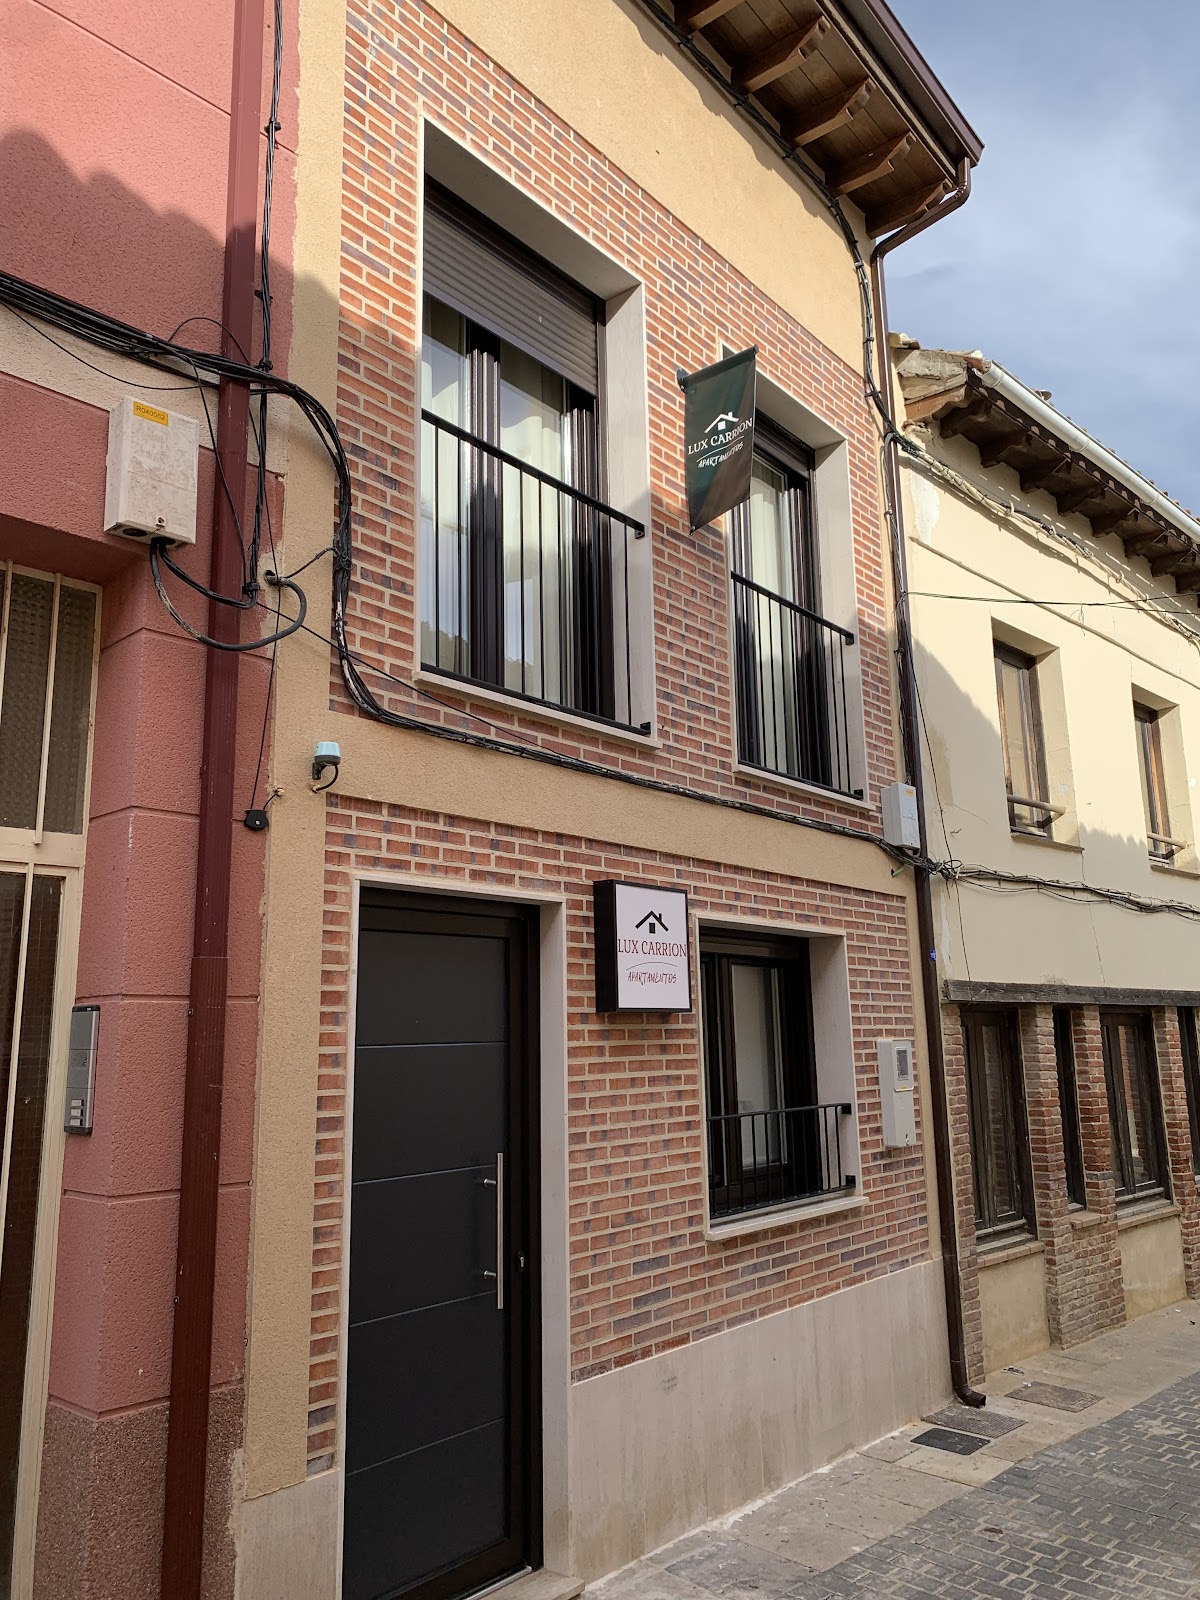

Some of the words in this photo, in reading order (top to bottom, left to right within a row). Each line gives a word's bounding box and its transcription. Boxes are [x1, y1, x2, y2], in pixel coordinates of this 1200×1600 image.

[688, 438, 709, 455] LUX
[710, 417, 753, 447] CARRION
[697, 441, 744, 469] APARTAMENTOS
[617, 938, 639, 954] LUX
[641, 940, 687, 958] CARRION
[627, 971, 677, 986] APARTAMENTOS
